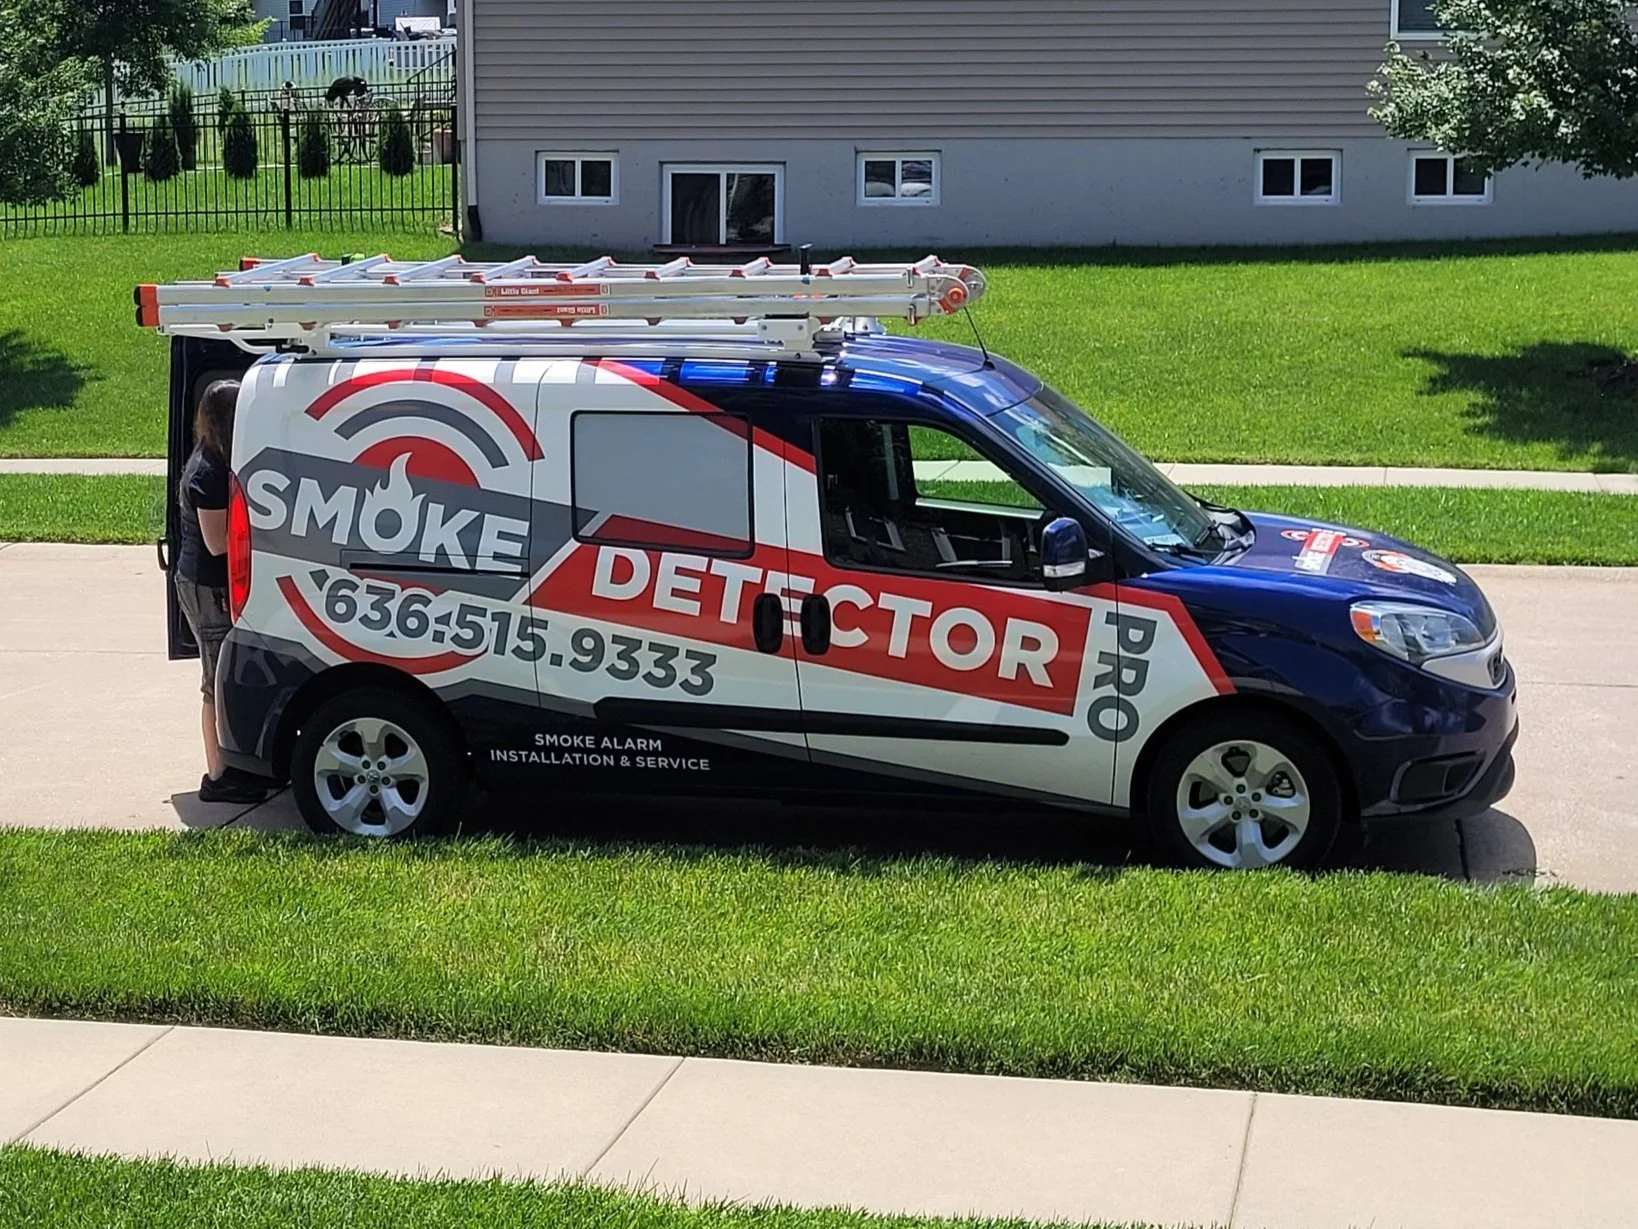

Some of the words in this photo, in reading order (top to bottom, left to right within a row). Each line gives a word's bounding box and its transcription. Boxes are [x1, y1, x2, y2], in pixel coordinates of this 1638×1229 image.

[501, 287, 520, 296] Little
[521, 287, 540, 296] Giant
[246, 452, 531, 580] SMOKE
[324, 578, 717, 696] 636.515.9333
[591, 547, 1060, 688] DETECTOR
[1086, 611, 1157, 743] PRO
[490, 749, 615, 766] INSTALLATION
[619, 756, 631, 767] &
[636, 756, 711, 770] SERVICE
[534, 733, 596, 748] SMOKE
[600, 737, 662, 751] ALARM
